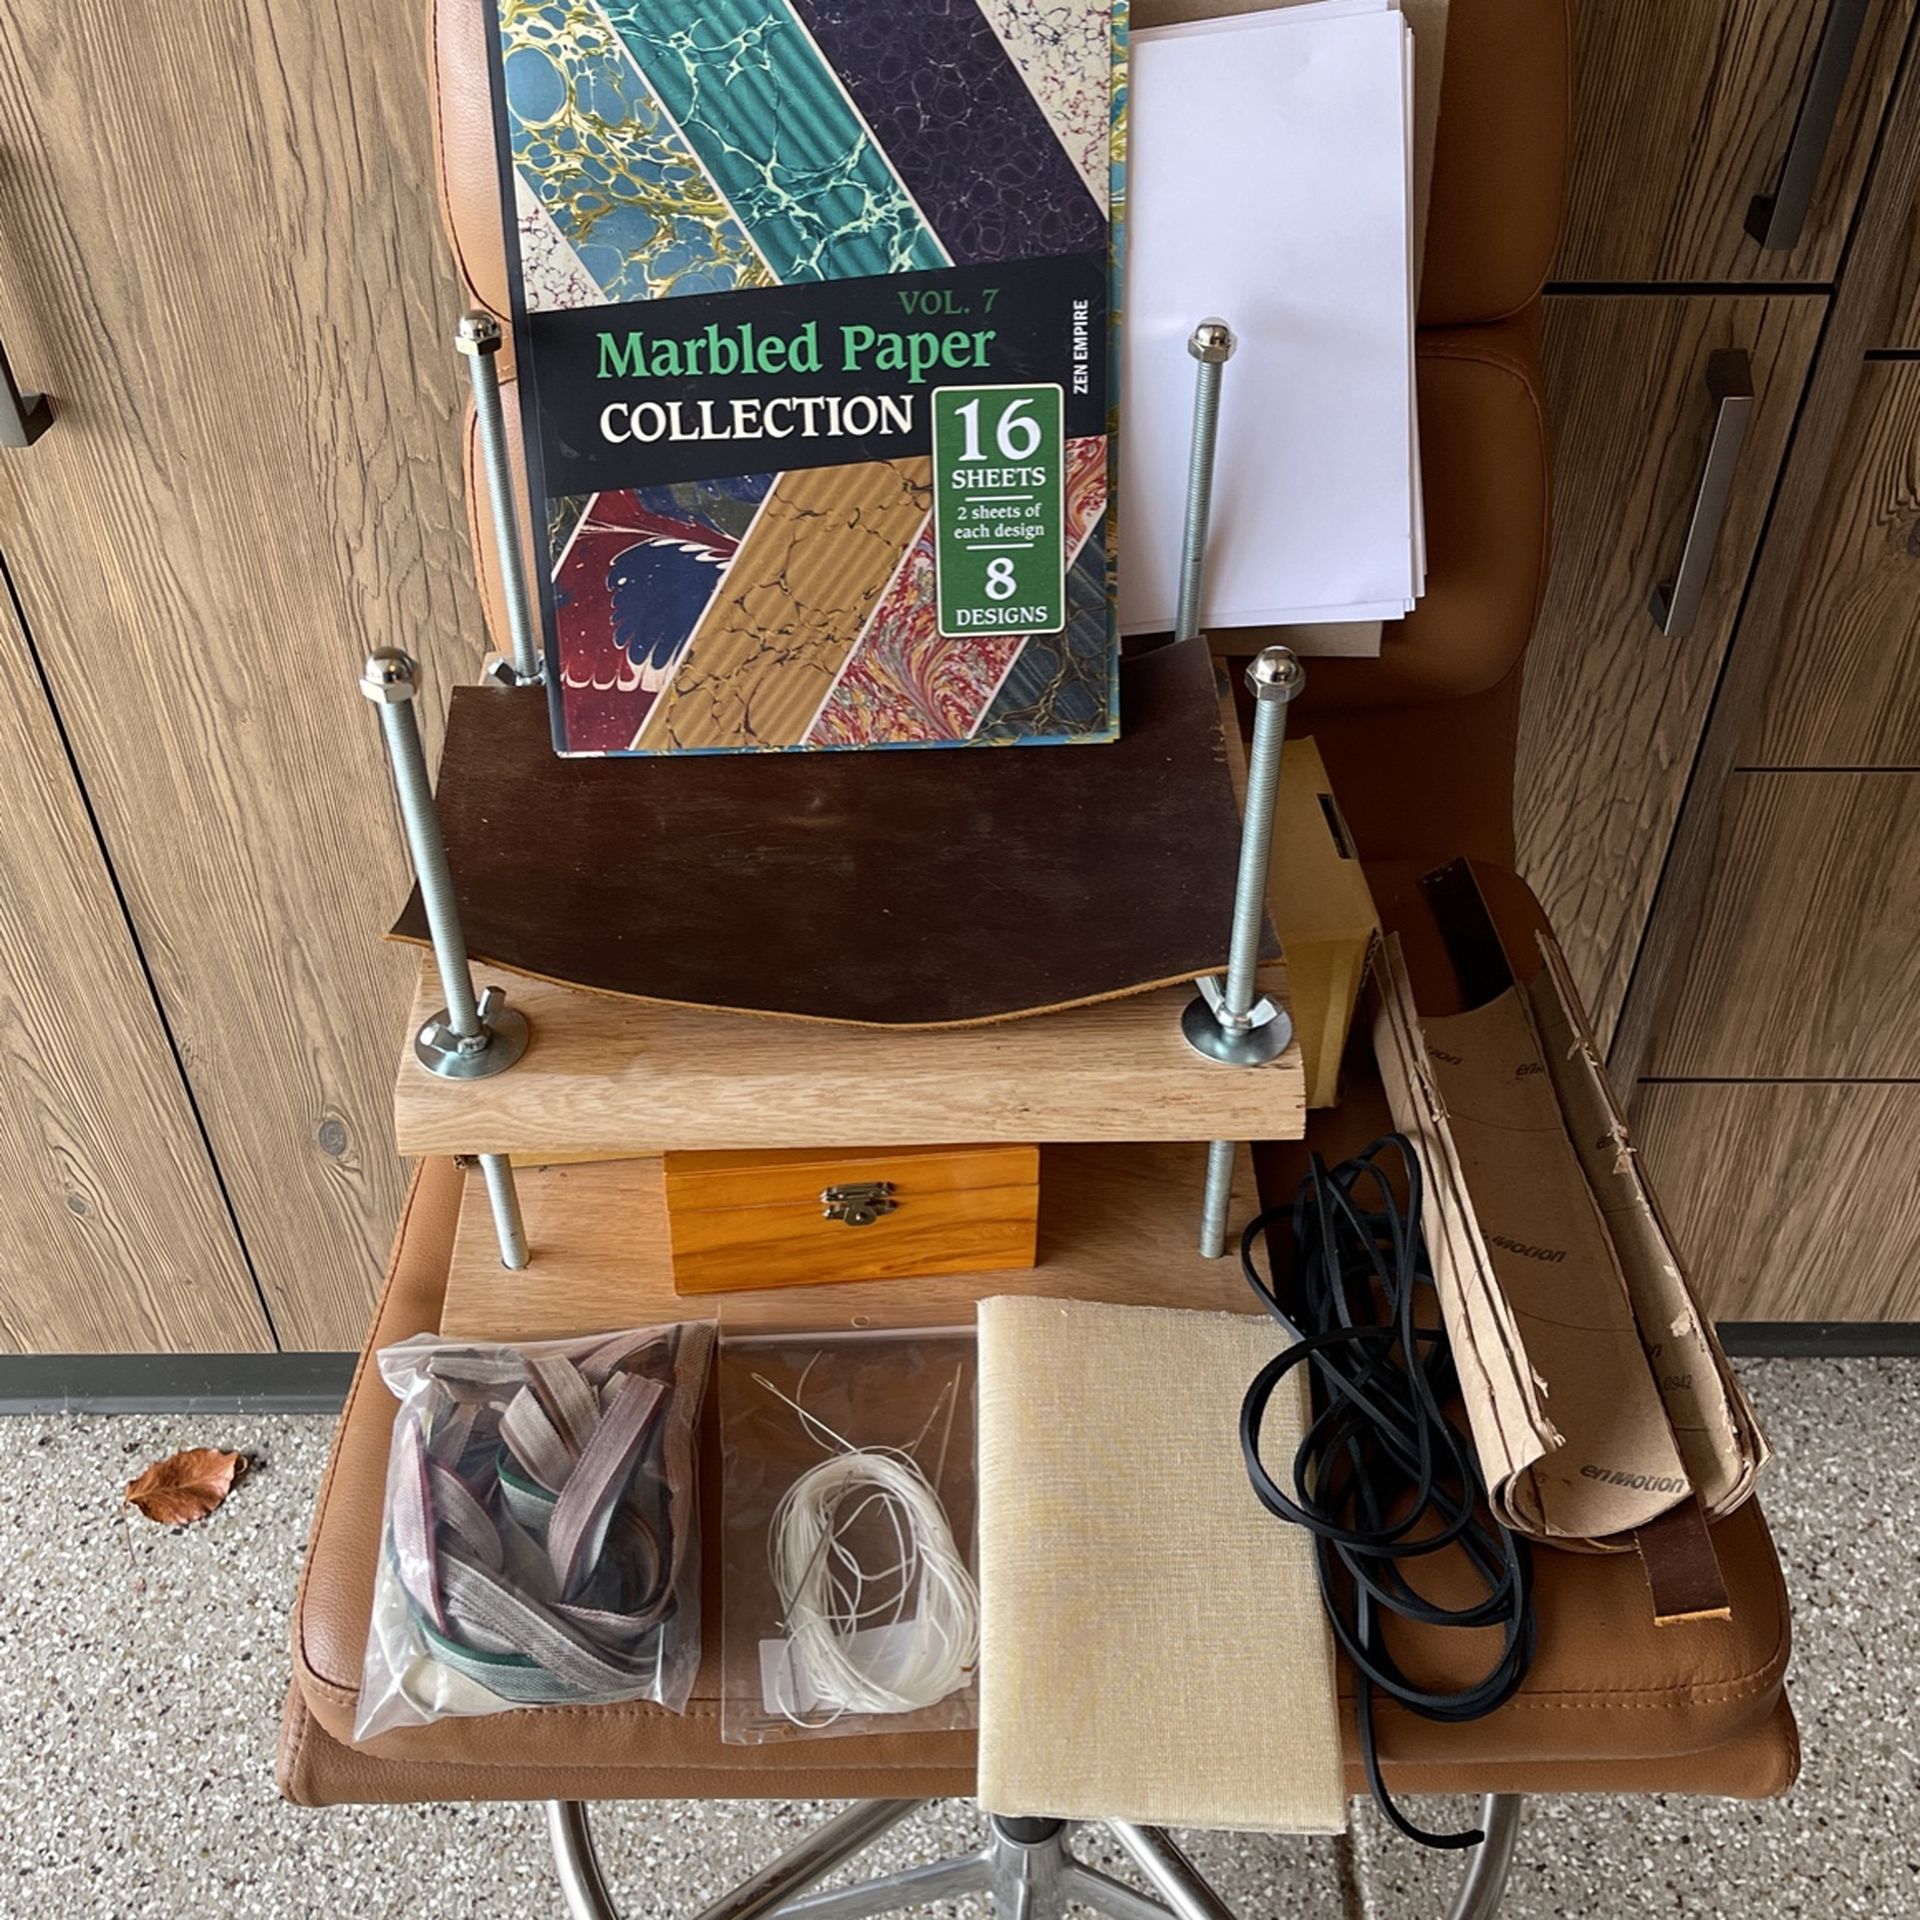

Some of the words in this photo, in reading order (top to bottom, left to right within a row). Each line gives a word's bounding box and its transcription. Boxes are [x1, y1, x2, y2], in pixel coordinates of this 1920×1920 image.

[899, 289, 970, 315] VOL.
[982, 288, 999, 313] 7
[1073, 299, 1089, 360] EMPIRE
[596, 320, 823, 379] Marbled
[839, 324, 997, 384] Paper
[1073, 364, 1089, 394] ZEN
[600, 395, 914, 443] COLLECTION
[954, 398, 1042, 461] 16
[952, 467, 1046, 489] SHEETS
[957, 507, 967, 520] 2
[971, 504, 1021, 519] sheets
[1025, 503, 1042, 517] of
[954, 524, 990, 539] each
[994, 523, 1045, 540] design
[985, 557, 1017, 600] 8
[955, 606, 1048, 626] DESIGNS
